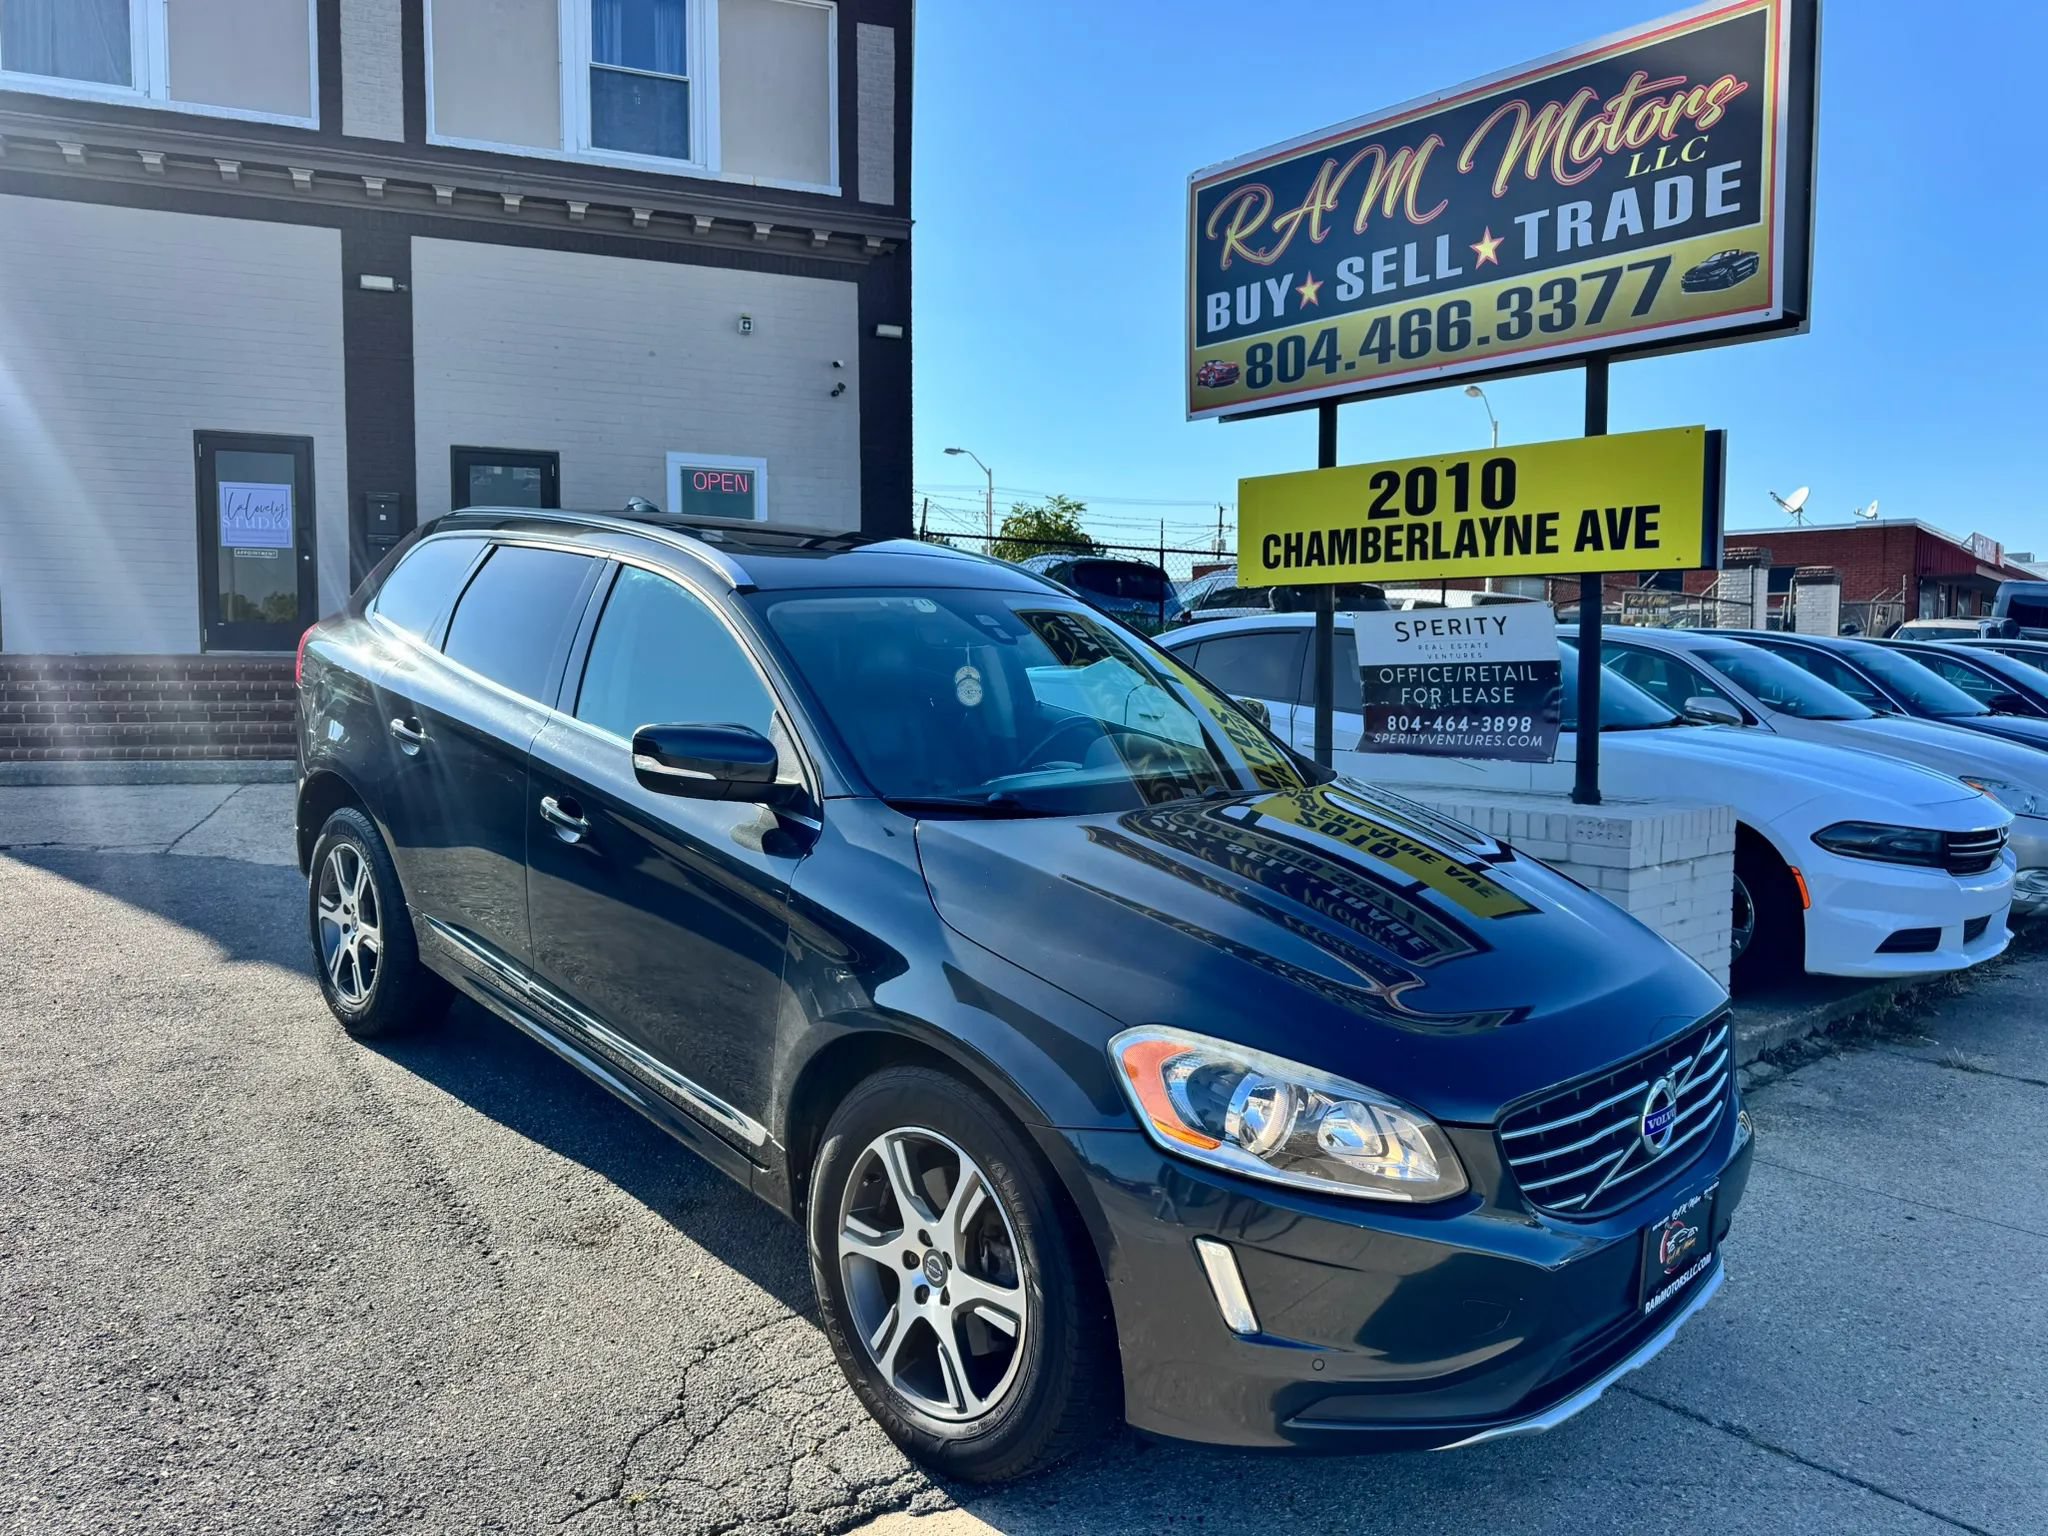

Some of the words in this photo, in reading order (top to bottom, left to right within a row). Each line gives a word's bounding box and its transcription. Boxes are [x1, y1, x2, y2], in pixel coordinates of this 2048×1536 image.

[1625, 135, 1709, 179] LLC
[1204, 134, 1449, 271] RAM
[1456, 70, 1749, 198] Motors
[1205, 273, 1295, 335] BUY
[1336, 233, 1463, 303] SELL
[1514, 160, 1742, 261] TRADE
[1245, 254, 1674, 391] 804.466.3377
[693, 471, 748, 493] OPEN
[1367, 457, 1517, 521] 2010
[222, 515, 290, 530] STUDIO
[1262, 511, 1560, 570] CHAMBERLAYNE
[1574, 504, 1661, 552] AVE
[1394, 615, 1508, 643] SPERITY
[1427, 652, 1483, 660] VENTURES
[1450, 642, 1489, 650] ESTATE
[1379, 665, 1539, 684] OFFICE/RETAIL
[1401, 687, 1442, 704] FOR
[1451, 686, 1515, 704] LEASE
[1387, 715, 1532, 733] 804-464-3898
[1373, 733, 1543, 748] SPERITYVENTURES.COM
